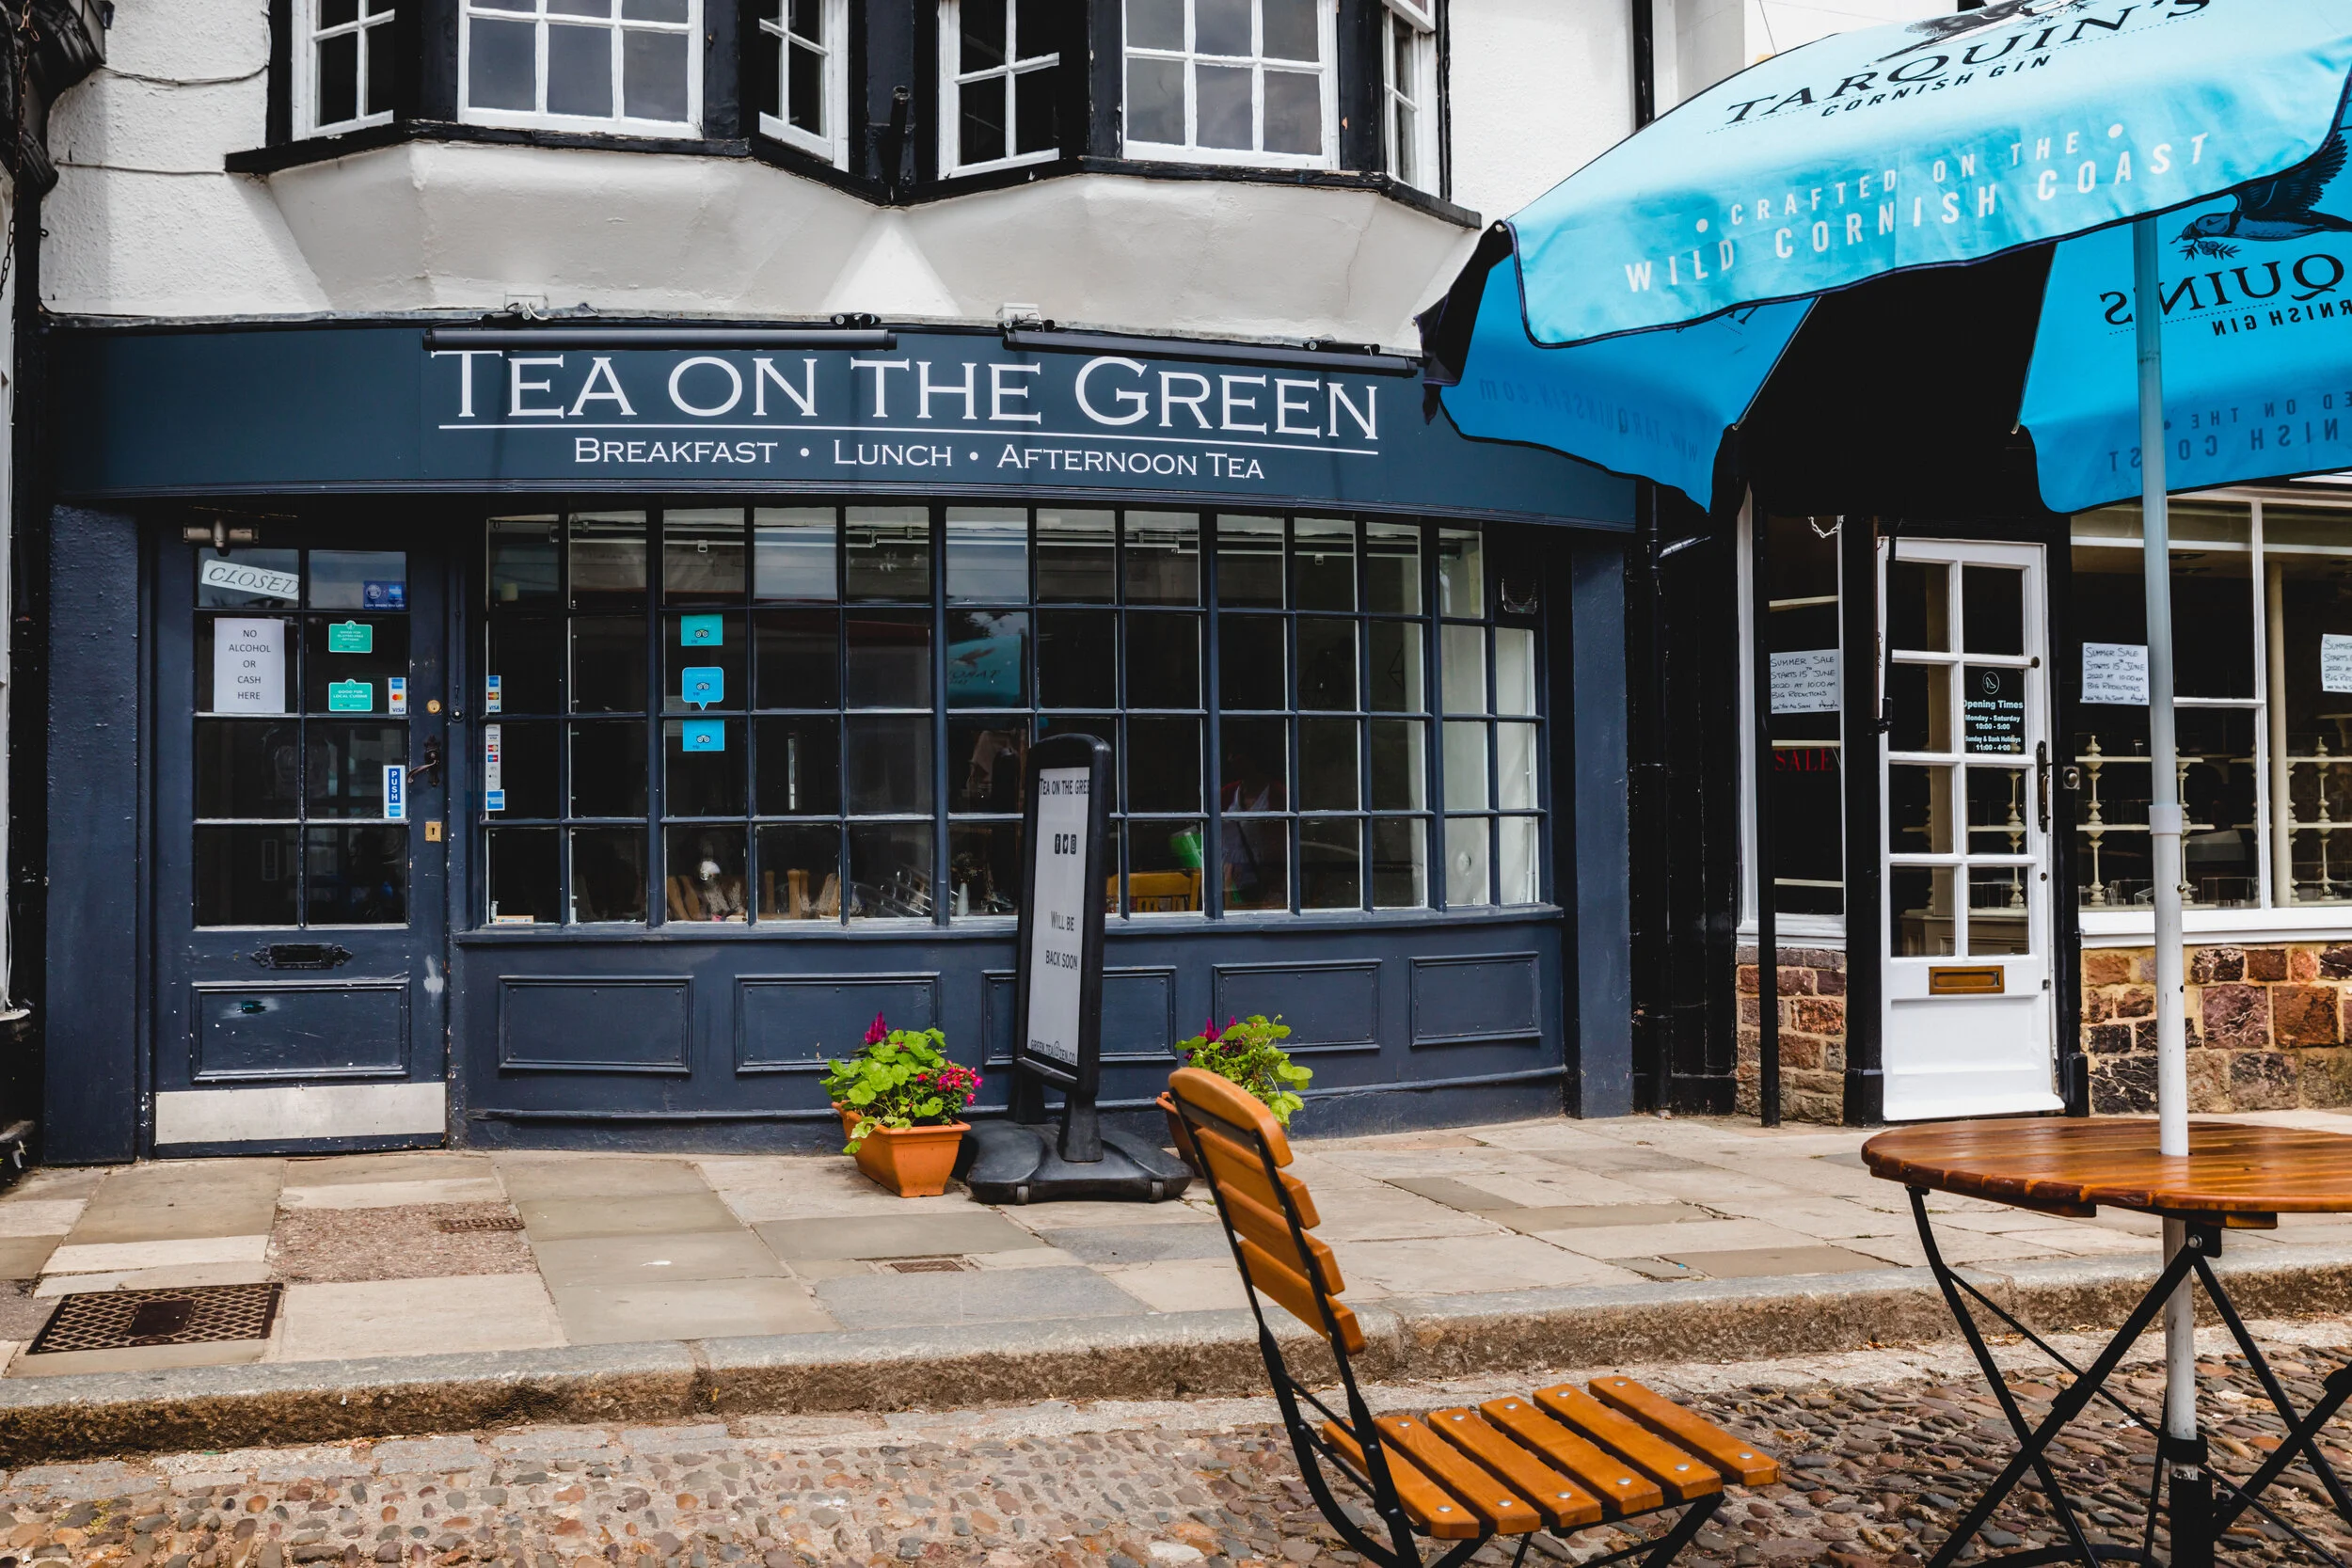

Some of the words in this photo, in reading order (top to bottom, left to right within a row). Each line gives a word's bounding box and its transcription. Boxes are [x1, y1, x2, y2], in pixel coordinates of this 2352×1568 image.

[1821, 72, 1973, 118] CORNISH
[1989, 55, 2050, 78] GIN
[1731, 169, 1897, 226] CRAFTED
[1932, 153, 1975, 182] ON
[2010, 131, 2079, 166] THE
[1625, 239, 1734, 293] WILD
[1775, 183, 1996, 259] CORNISH
[2037, 132, 2209, 200] COAST
[430, 349, 637, 419] TEA
[668, 356, 818, 417] ON
[850, 356, 1041, 424] THE
[1075, 356, 1378, 439] GREEN
[575, 437, 778, 465] BREAKFAST
[834, 439, 952, 467] LUNCH
[997, 444, 1198, 477] AFTERNOON
[1206, 452, 1264, 480] TEA
[209, 566, 299, 594] CLOSED
[243, 629, 257, 638] NO
[229, 643, 271, 653] ALCOHOL
[2086, 647, 2115, 657] SUMMER
[2117, 647, 2139, 657] SALE
[243, 659, 256, 668] OR
[1770, 657, 1806, 667] SUMMER
[1812, 656, 1835, 665] SALE
[2086, 660, 2110, 671] STARTS
[2123, 661, 2145, 671] JUNE
[237, 675, 261, 684] CASH
[1771, 671, 1797, 679] STARTS
[237, 691, 261, 700] HERE
[1963, 699, 1995, 710] Opening
[1997, 700, 2024, 709] Times
[1964, 714, 1989, 722] Monday
[1993, 715, 2021, 723] Saturday
[1964, 735, 1982, 743] Sunday
[1774, 748, 1834, 771] SALE
[1040, 778, 1050, 796] TEA
[1052, 780, 1060, 795] ON
[1061, 780, 1073, 795] THE
[1050, 910, 1065, 930] WILL
[1066, 916, 1074, 932] BE
[1045, 949, 1060, 967] BACK
[1061, 952, 1077, 970] SOON
